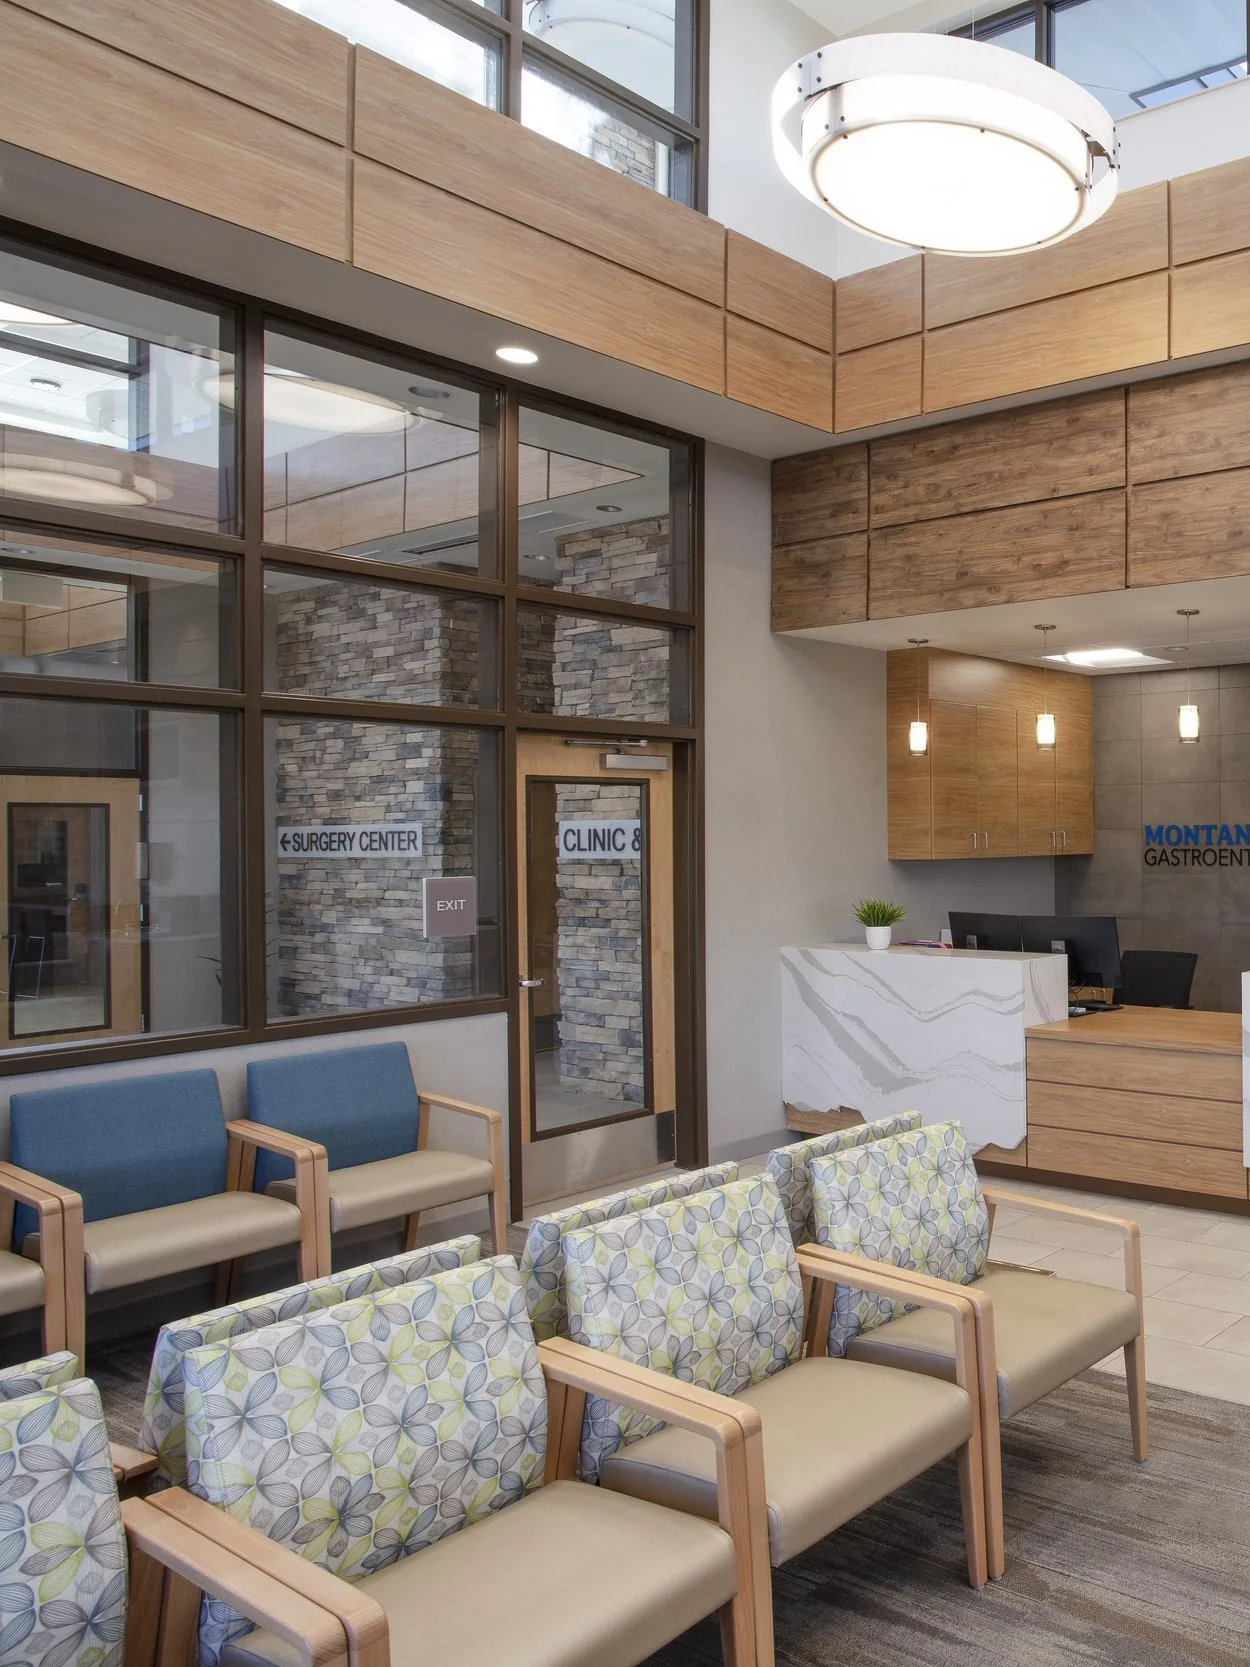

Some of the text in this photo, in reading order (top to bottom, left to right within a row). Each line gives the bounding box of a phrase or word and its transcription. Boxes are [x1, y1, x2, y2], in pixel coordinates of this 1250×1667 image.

[292, 830, 419, 852] SURGERY CENTER
[563, 828, 626, 852] CLINIC
[436, 899, 467, 911] EXIT
